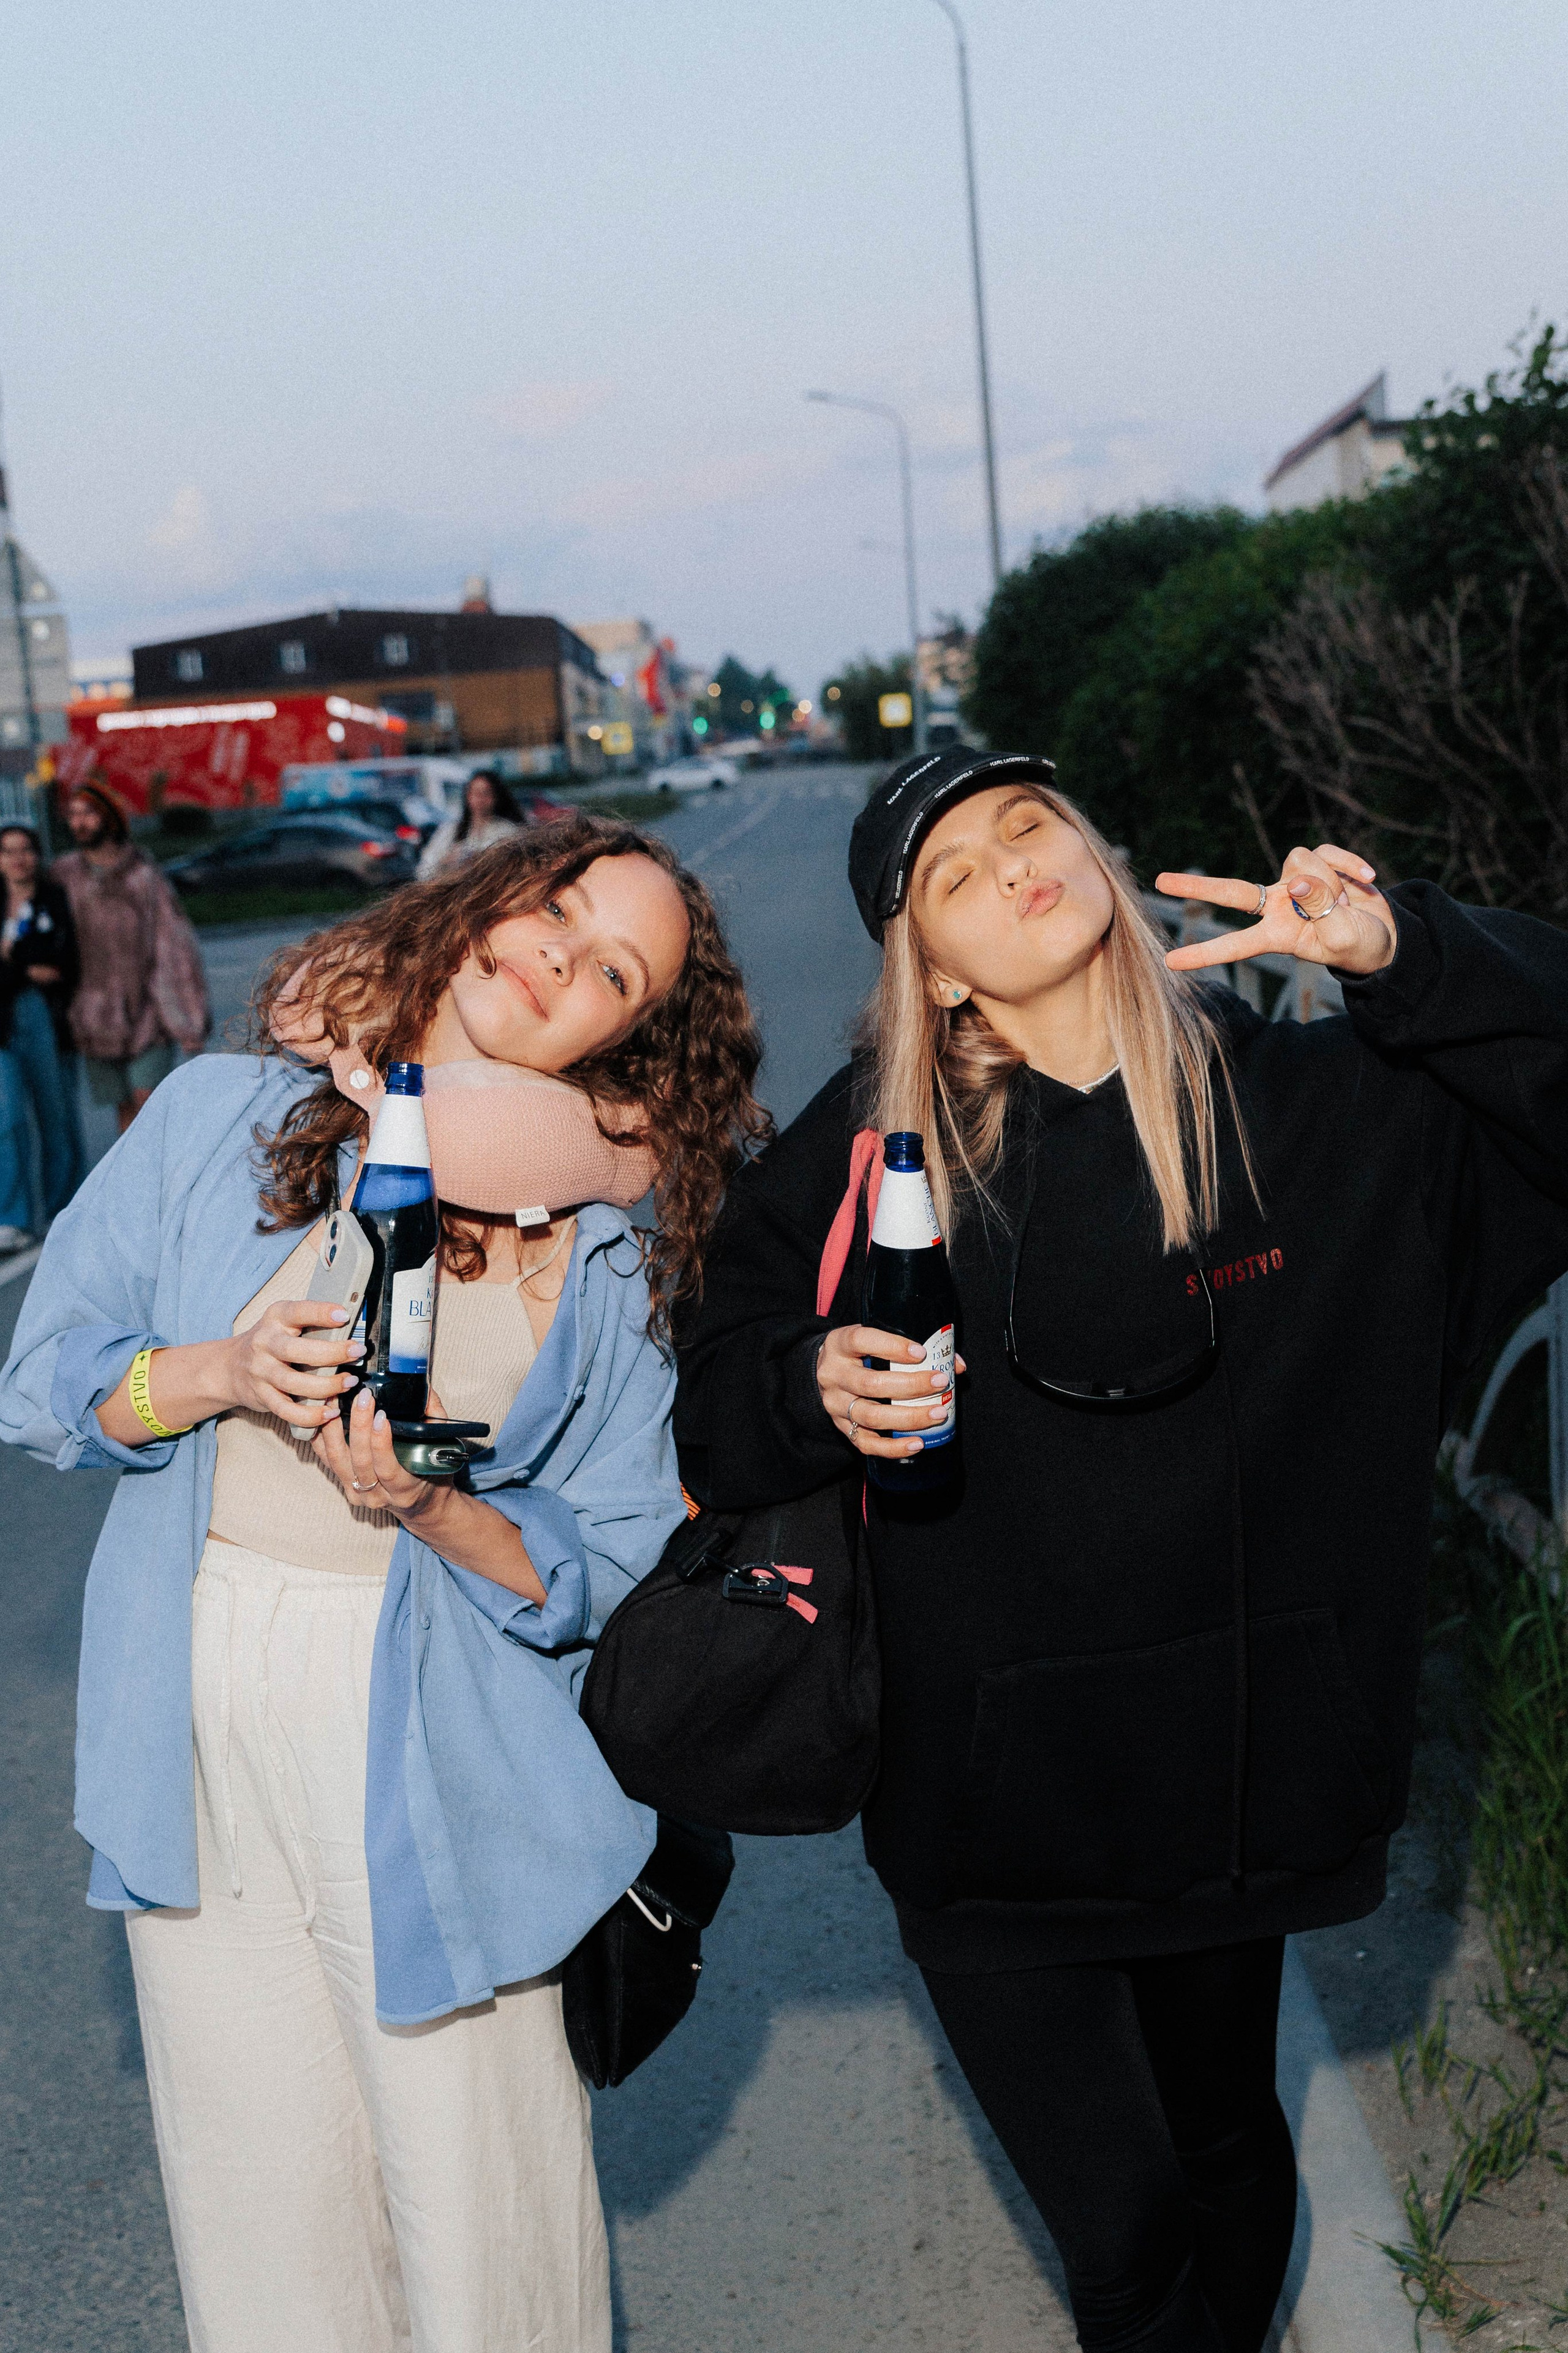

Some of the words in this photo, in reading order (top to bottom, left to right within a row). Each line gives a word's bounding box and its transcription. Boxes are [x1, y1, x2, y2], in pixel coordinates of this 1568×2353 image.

[887, 787, 903, 804] KARL
[902, 757, 941, 786] LAGERFELD
[934, 787, 948, 798] KARL
[946, 770, 973, 788] LAGERFELD
[907, 812, 924, 840] LAGERFELD
[521, 1210, 546, 1219] NIERA
[1186, 1248, 1284, 1296] SOYSTVO
[409, 1300, 432, 1316] BLA
[932, 1359, 954, 1373] KRON
[933, 1351, 941, 1361] 13
[133, 1370, 172, 1436] VOYSTVO
